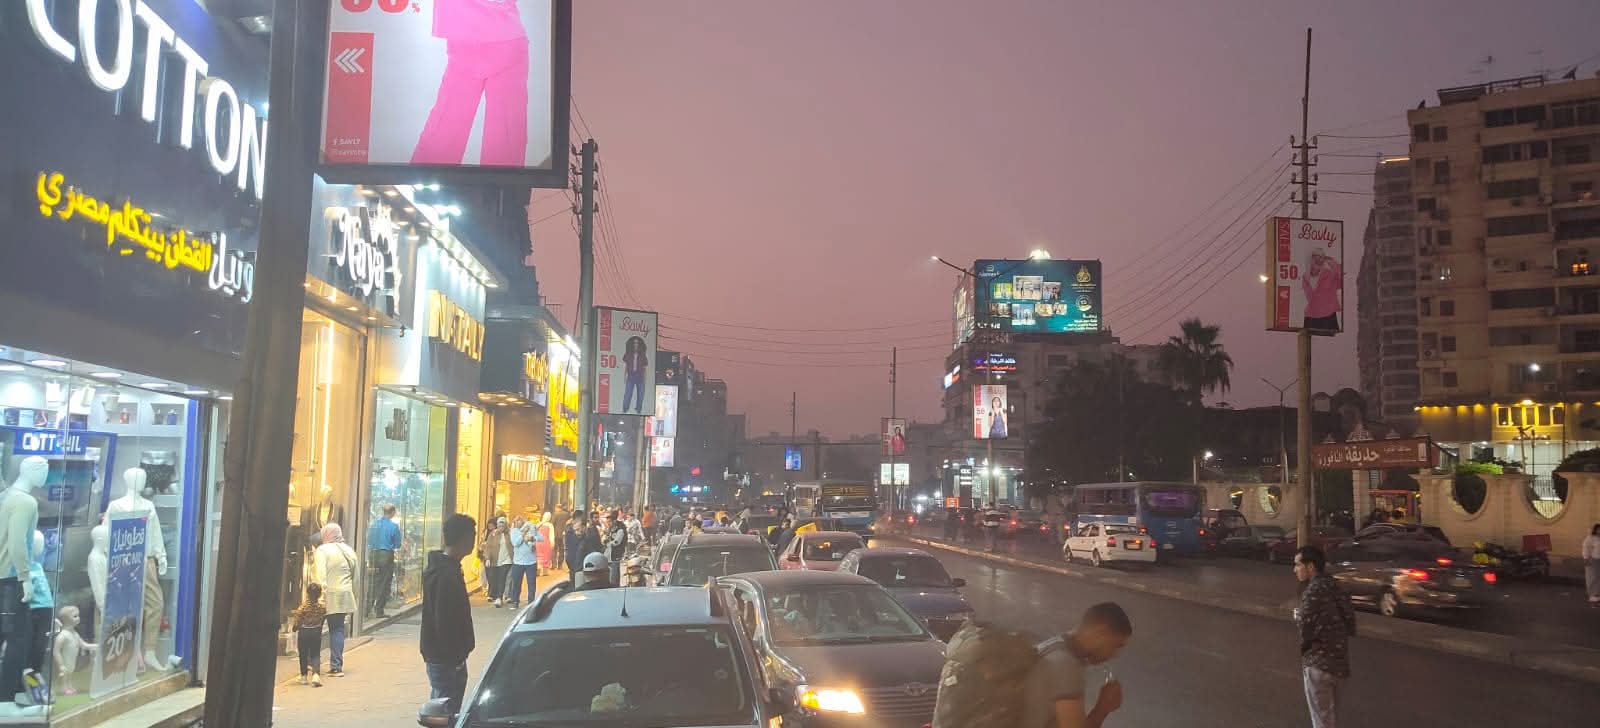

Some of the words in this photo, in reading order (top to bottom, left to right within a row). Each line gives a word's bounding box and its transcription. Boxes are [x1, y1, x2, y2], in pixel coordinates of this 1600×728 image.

[36, 171, 110, 220] مصري
[429, 290, 486, 362] NATALY
[105, 629, 133, 663] 20%
